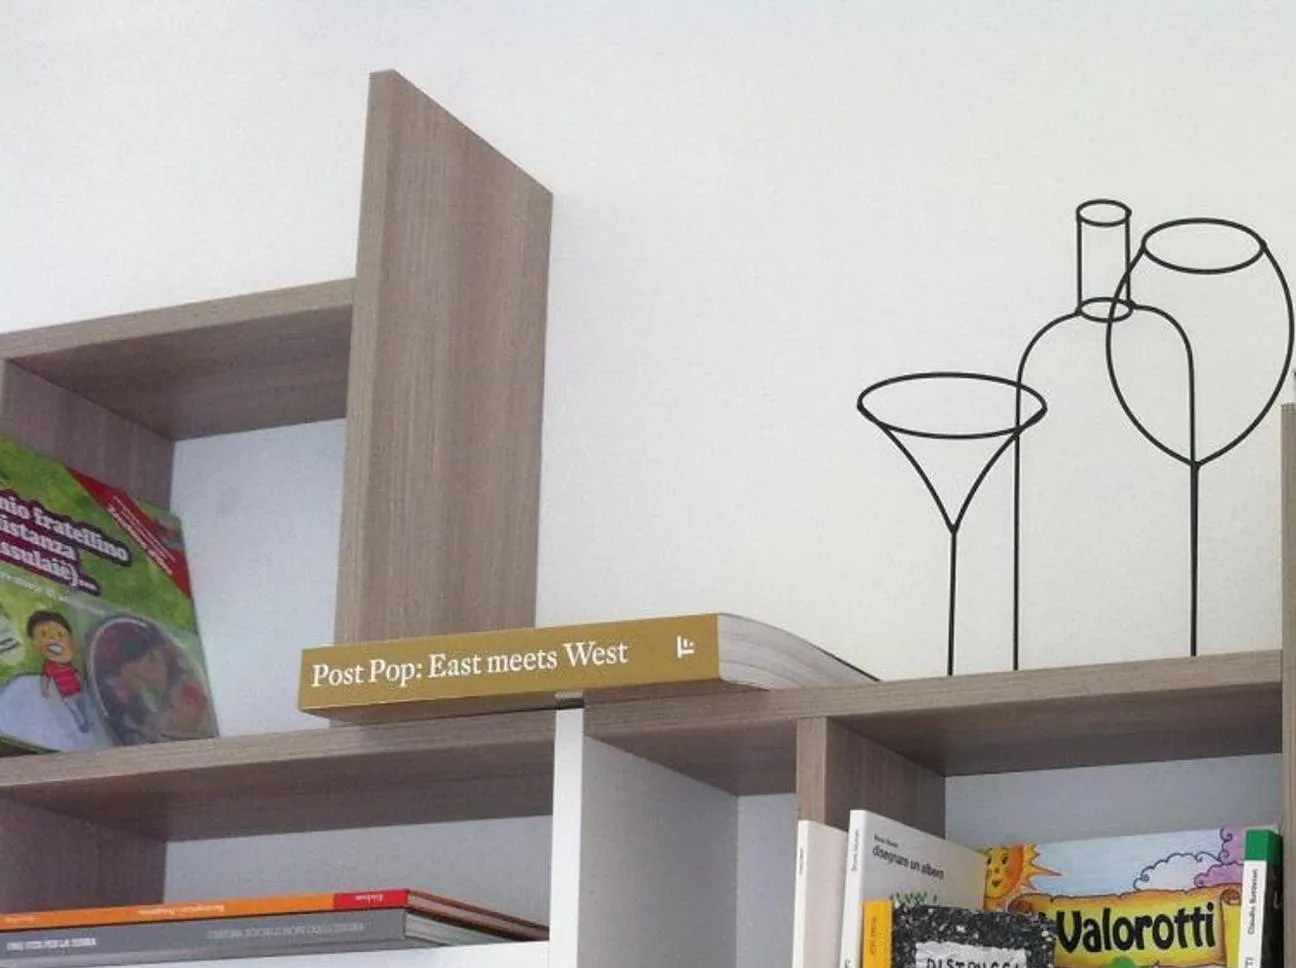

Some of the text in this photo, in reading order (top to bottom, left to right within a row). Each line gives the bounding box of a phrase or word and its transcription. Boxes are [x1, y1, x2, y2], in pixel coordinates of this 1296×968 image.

[0, 514, 77, 560] istanza
[33, 506, 129, 561] fratellino
[311, 641, 628, 688] Post Pop: East meets West
[910, 860, 920, 872] un
[1056, 901, 1216, 953] Valorotti
